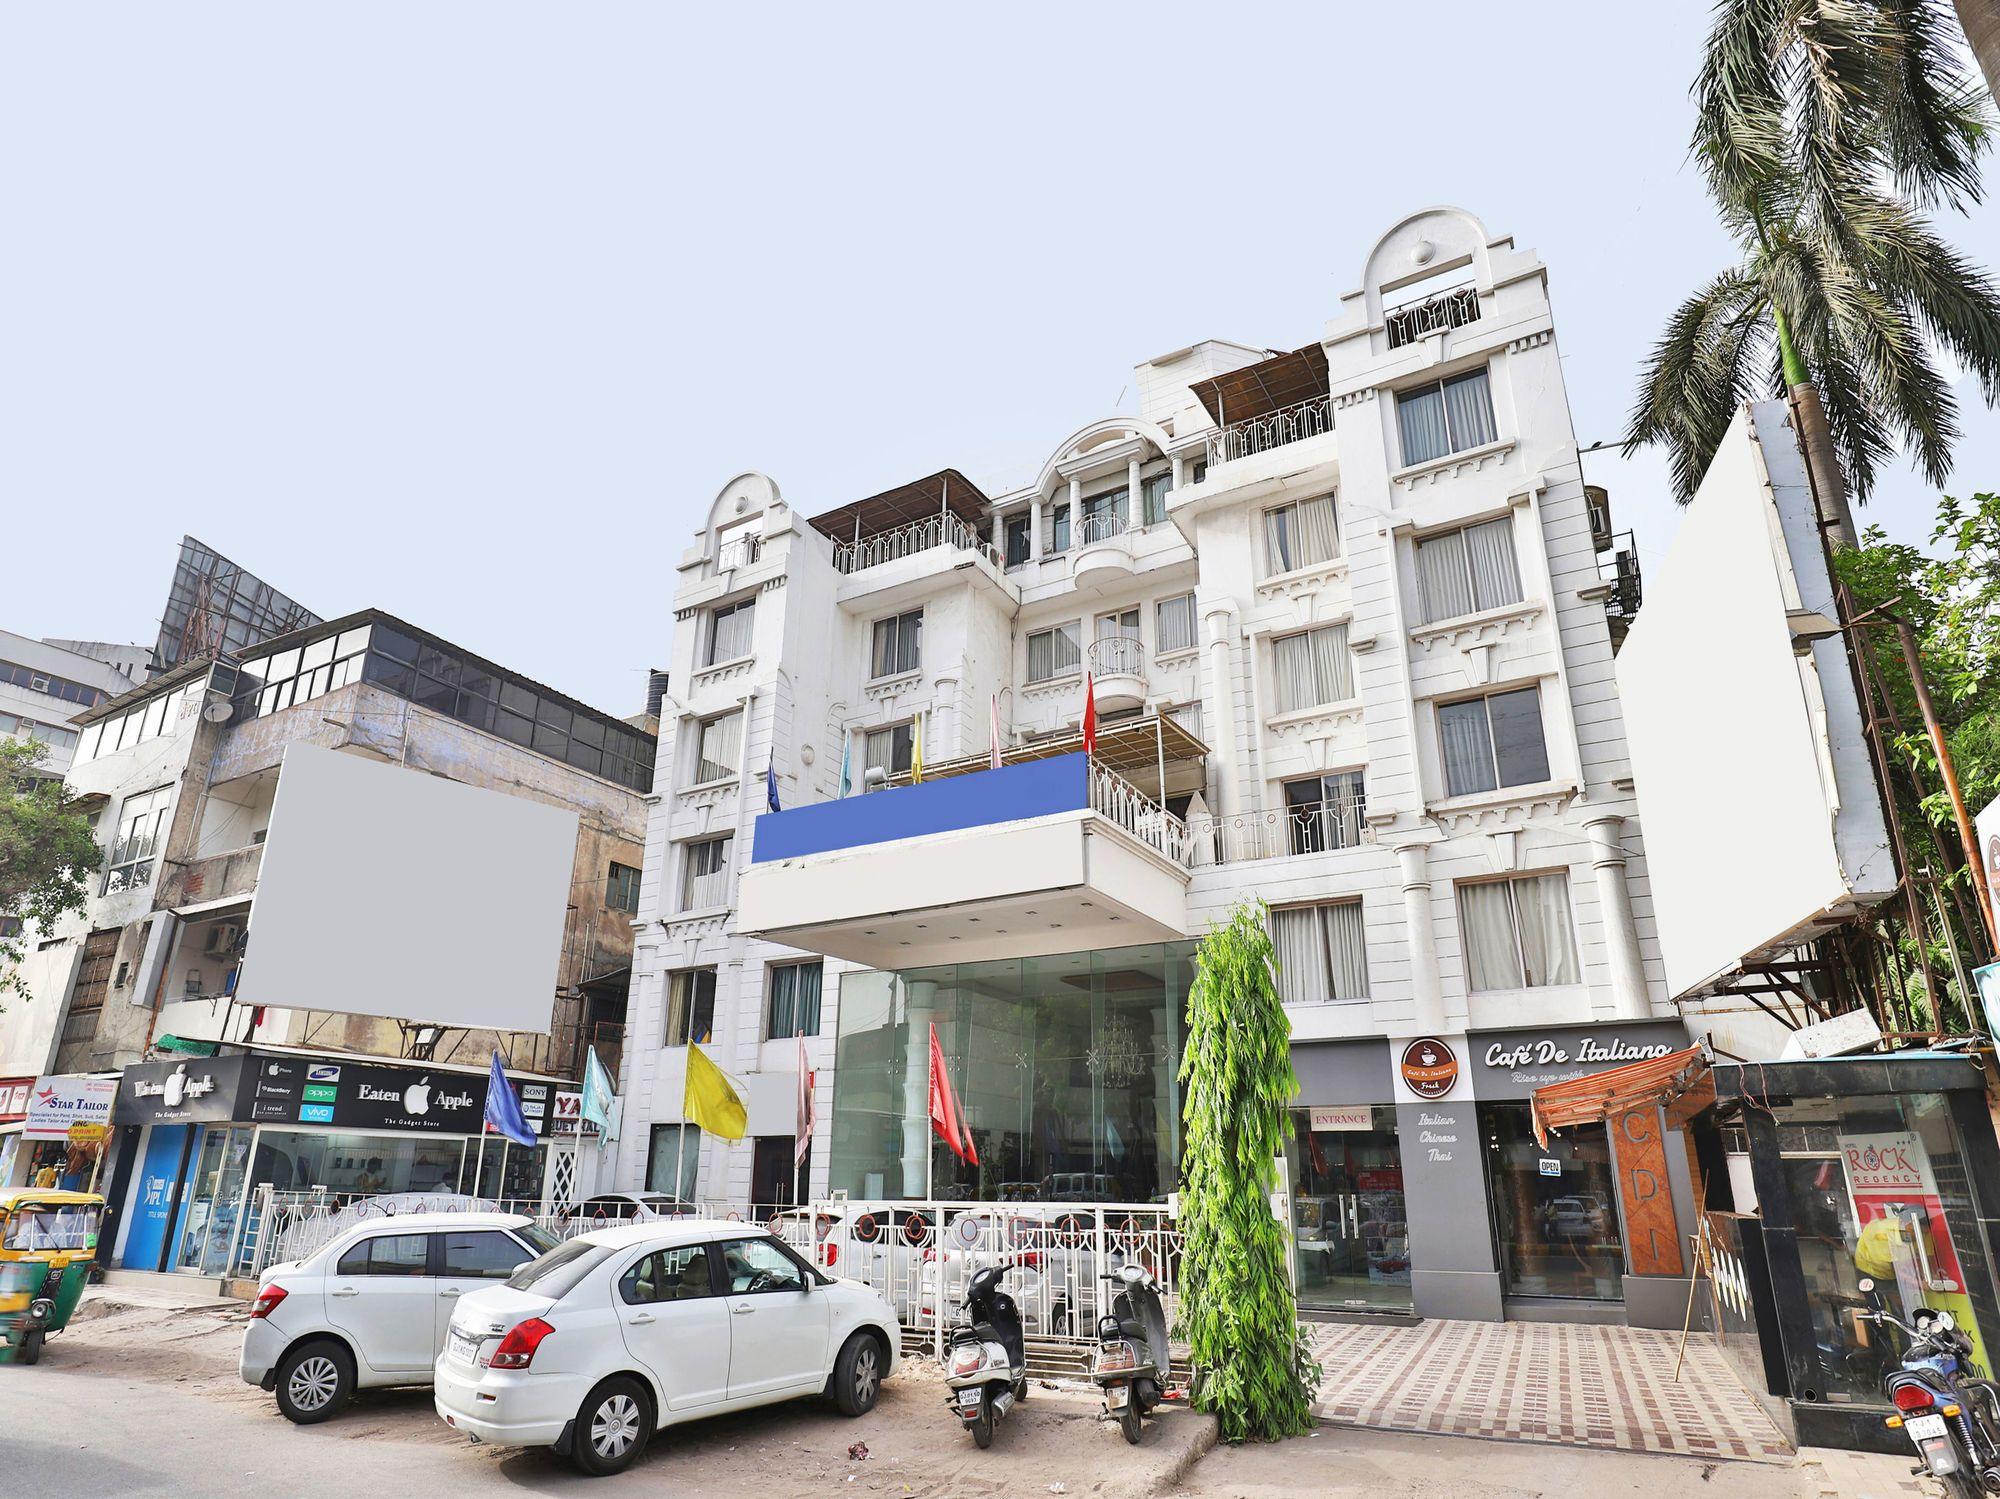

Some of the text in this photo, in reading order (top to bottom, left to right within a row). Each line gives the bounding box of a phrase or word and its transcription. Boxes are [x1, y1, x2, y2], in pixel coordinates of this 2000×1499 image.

[1485, 1038, 1672, 1069] Café De Italiano
[183, 1075, 214, 1098] Apple
[524, 1088, 546, 1096] SONY
[357, 1084, 473, 1110] Eaten Apple
[384, 1117, 440, 1127] The Gadget Store
[1316, 1114, 1367, 1124] ENTRANCE
[1418, 1112, 1456, 1126] Italian
[1419, 1130, 1458, 1143] Chinese
[1428, 1148, 1453, 1162] Thai
[1541, 1161, 1559, 1171] OPEN
